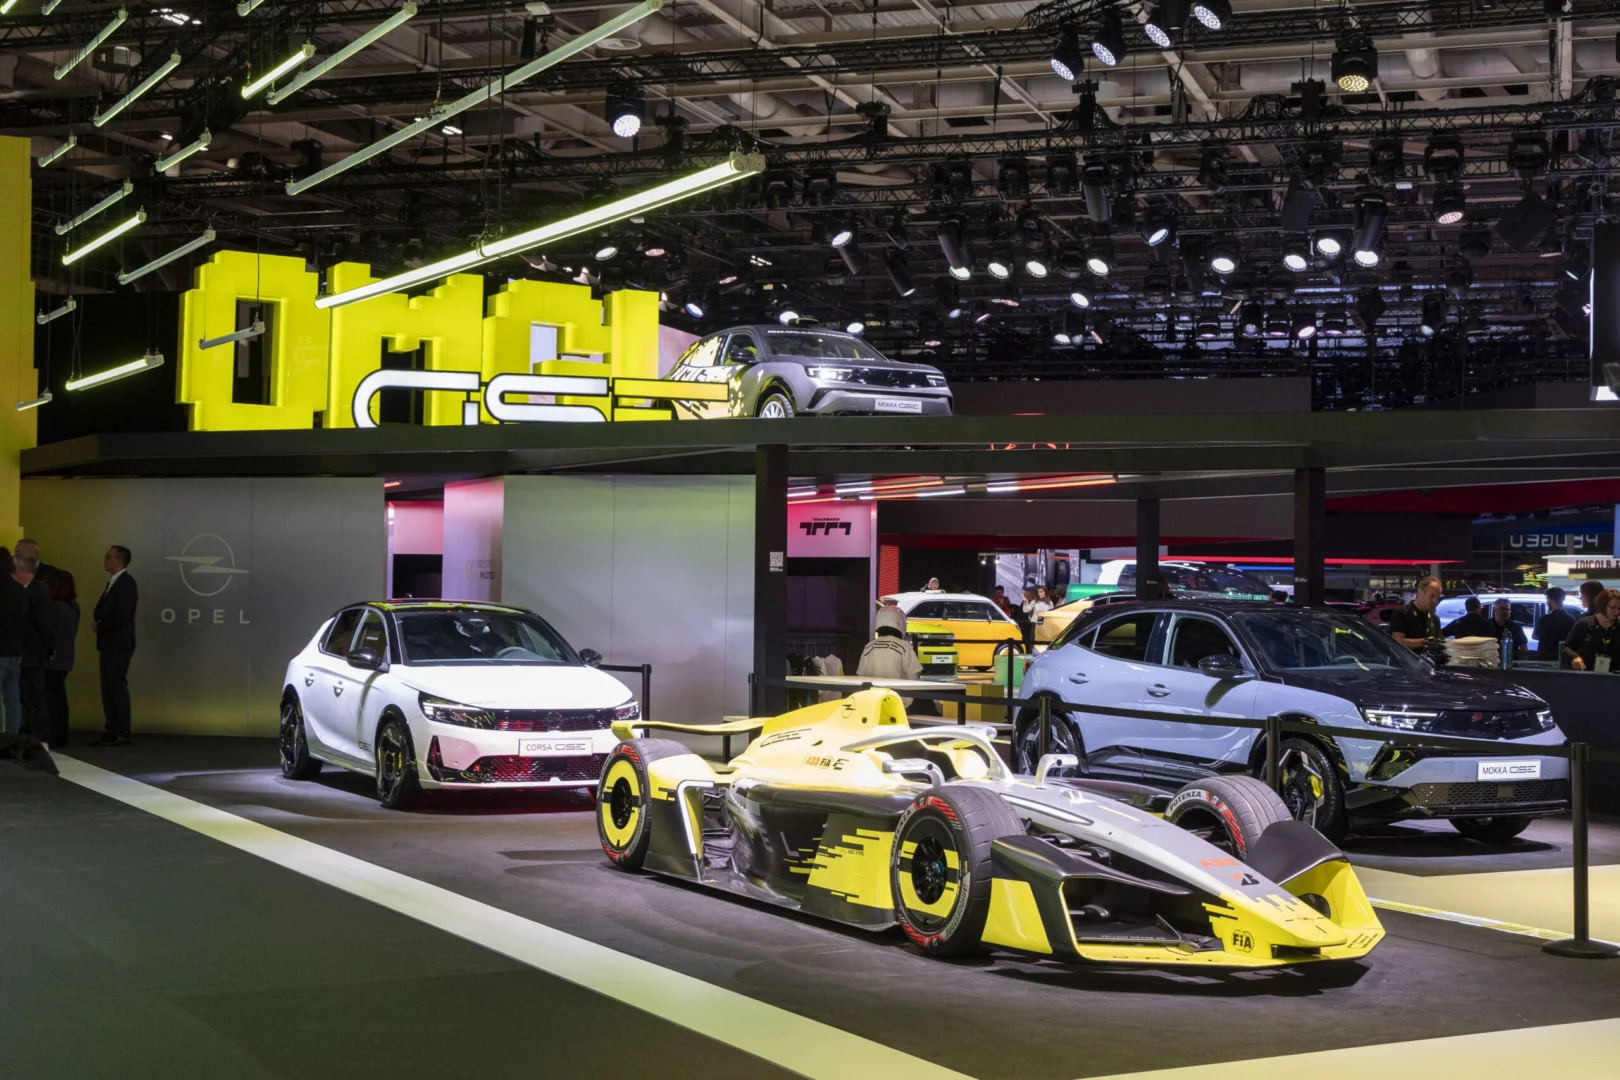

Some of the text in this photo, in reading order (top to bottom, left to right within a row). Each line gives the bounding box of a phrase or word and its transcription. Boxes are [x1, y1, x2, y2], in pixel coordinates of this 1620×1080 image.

[161, 607, 251, 624] OPEL
[526, 743, 586, 752] CORSA GSE
[1482, 765, 1537, 775] MOKKA GSE
[1169, 790, 1203, 812] POTENZA
[944, 883, 969, 938] BRIDGESTONE
